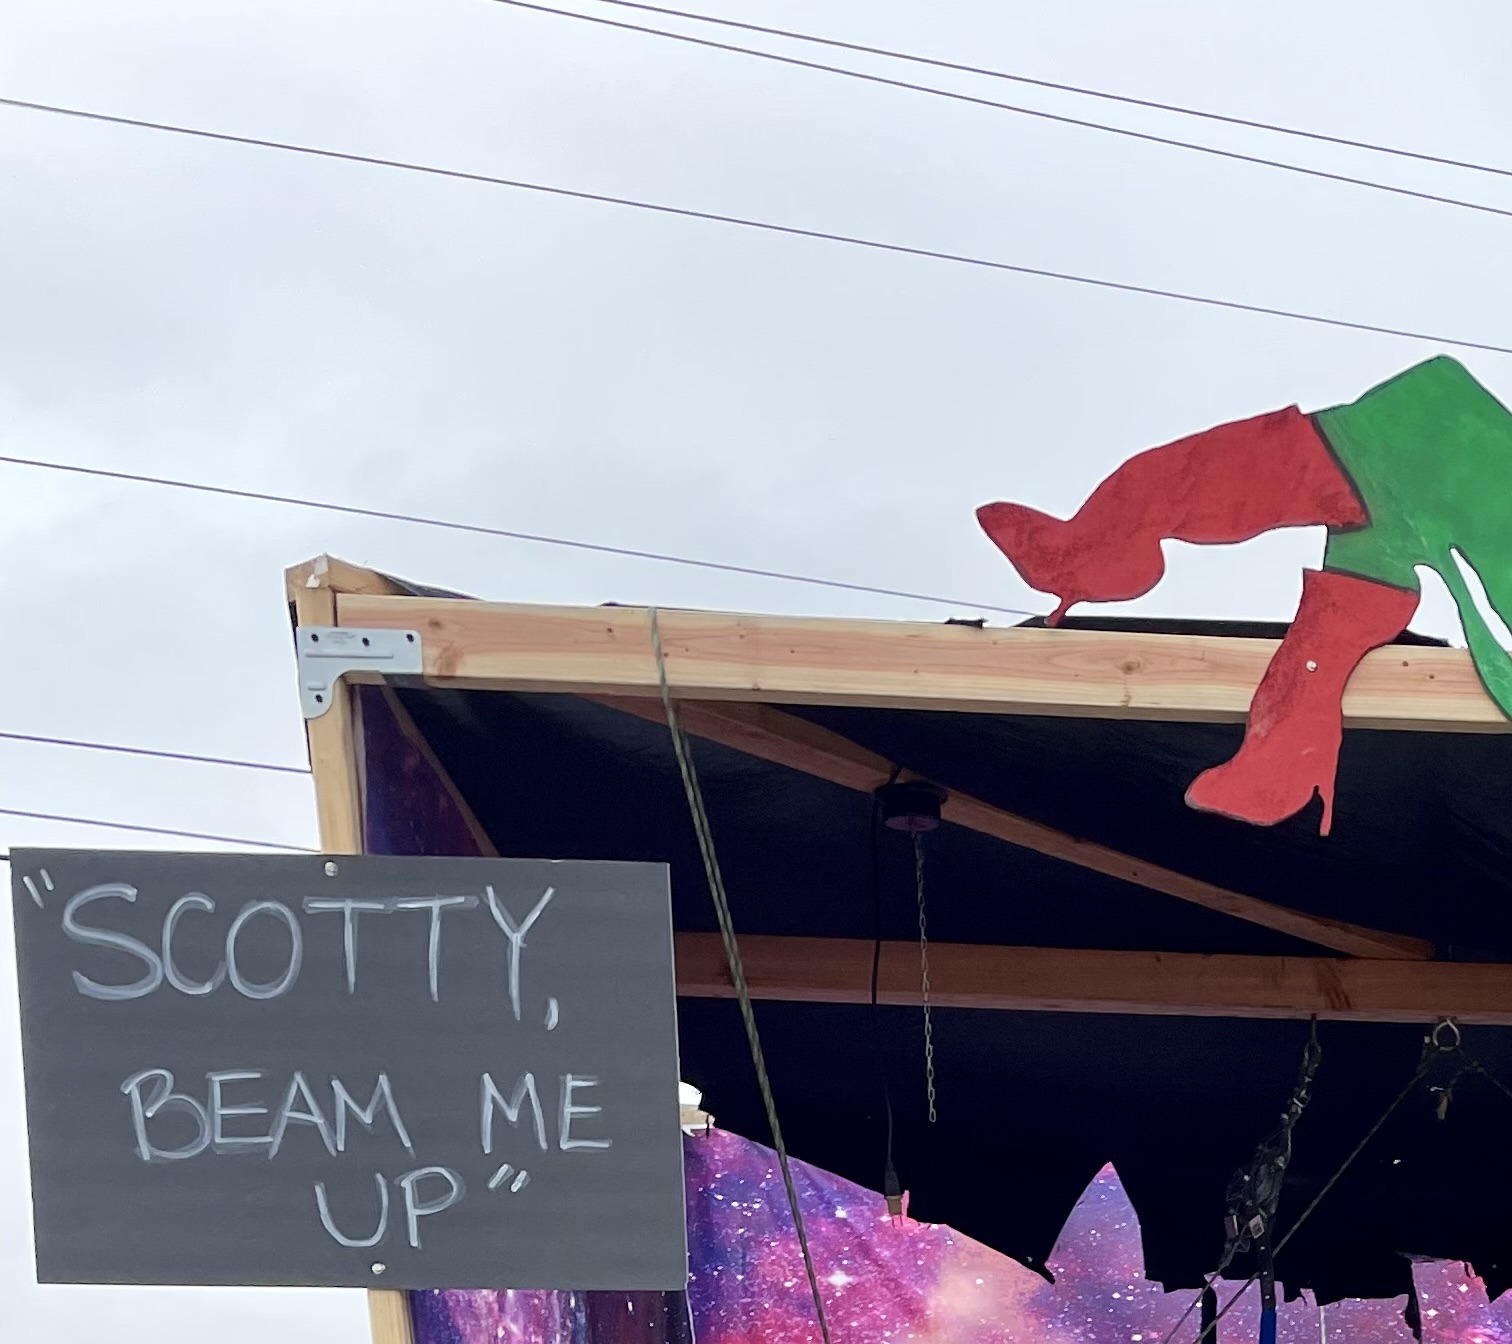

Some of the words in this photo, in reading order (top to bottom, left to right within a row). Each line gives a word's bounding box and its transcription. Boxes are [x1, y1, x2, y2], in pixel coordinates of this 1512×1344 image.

[23, 868, 559, 1030] "SCOTTY,
[121, 1068, 416, 1161] BEAM
[480, 1071, 612, 1155] ME
[313, 1163, 531, 1251] UP"
